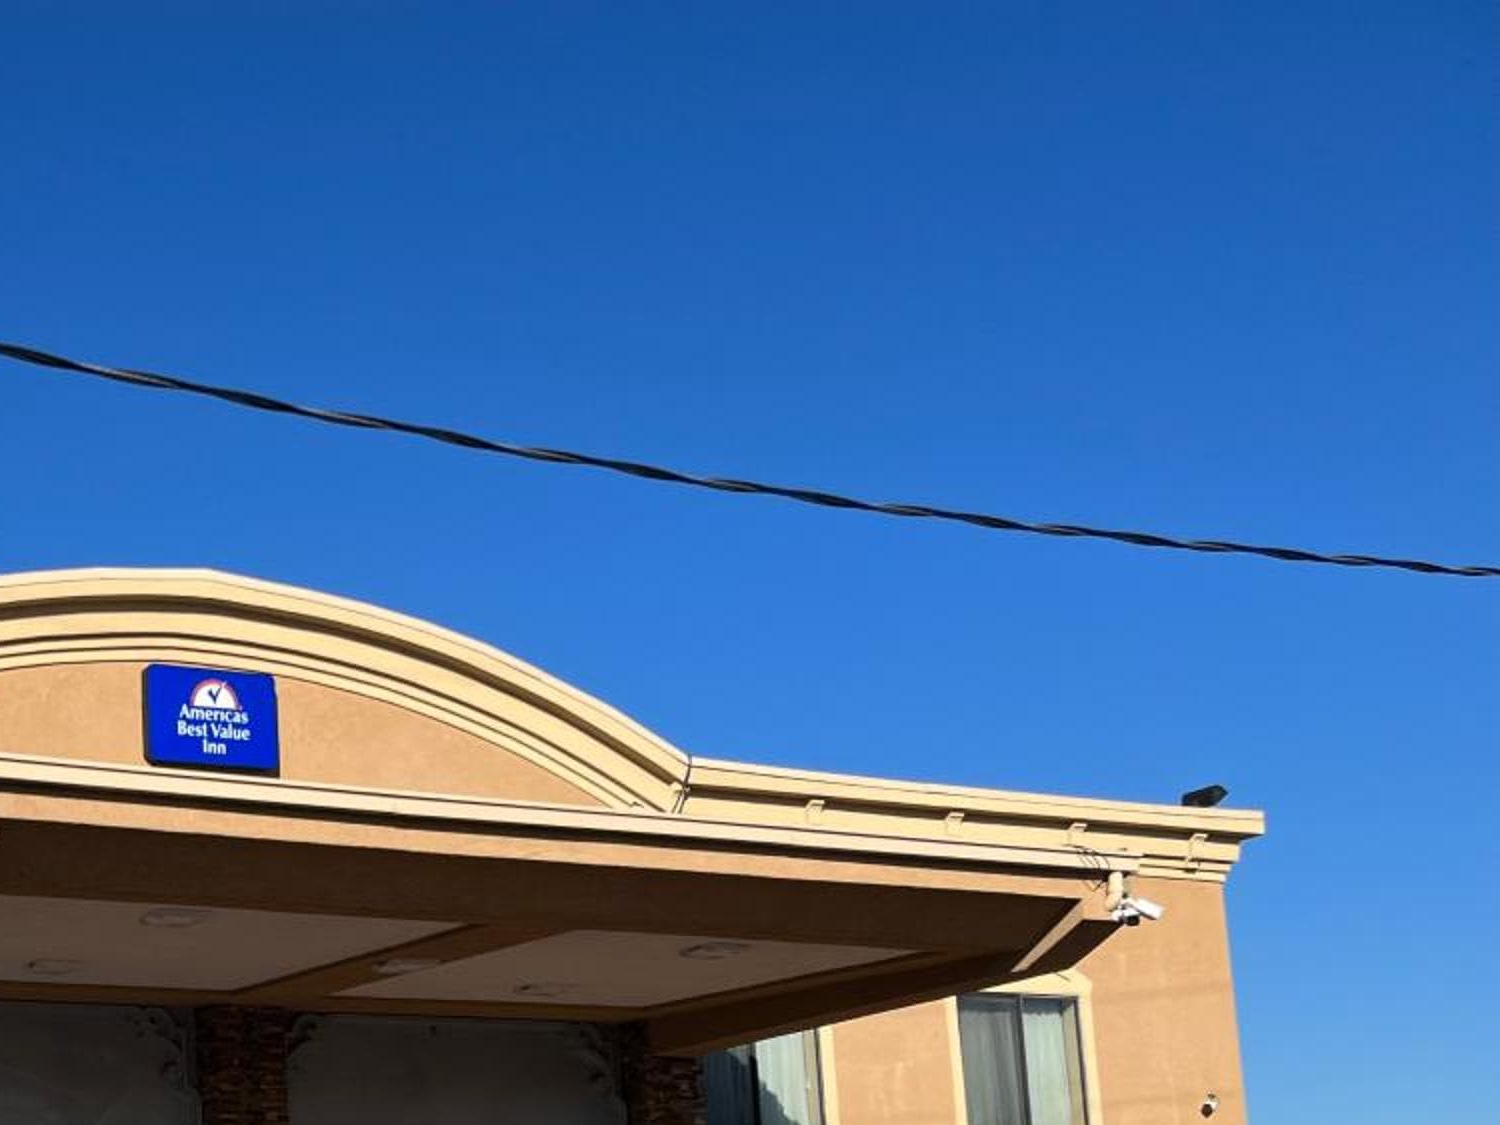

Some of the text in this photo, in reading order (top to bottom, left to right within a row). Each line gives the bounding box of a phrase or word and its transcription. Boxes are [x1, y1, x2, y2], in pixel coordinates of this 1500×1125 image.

[179, 703, 250, 724] Americas
[177, 720, 251, 741] Best Value
[202, 738, 227, 755] Inn
